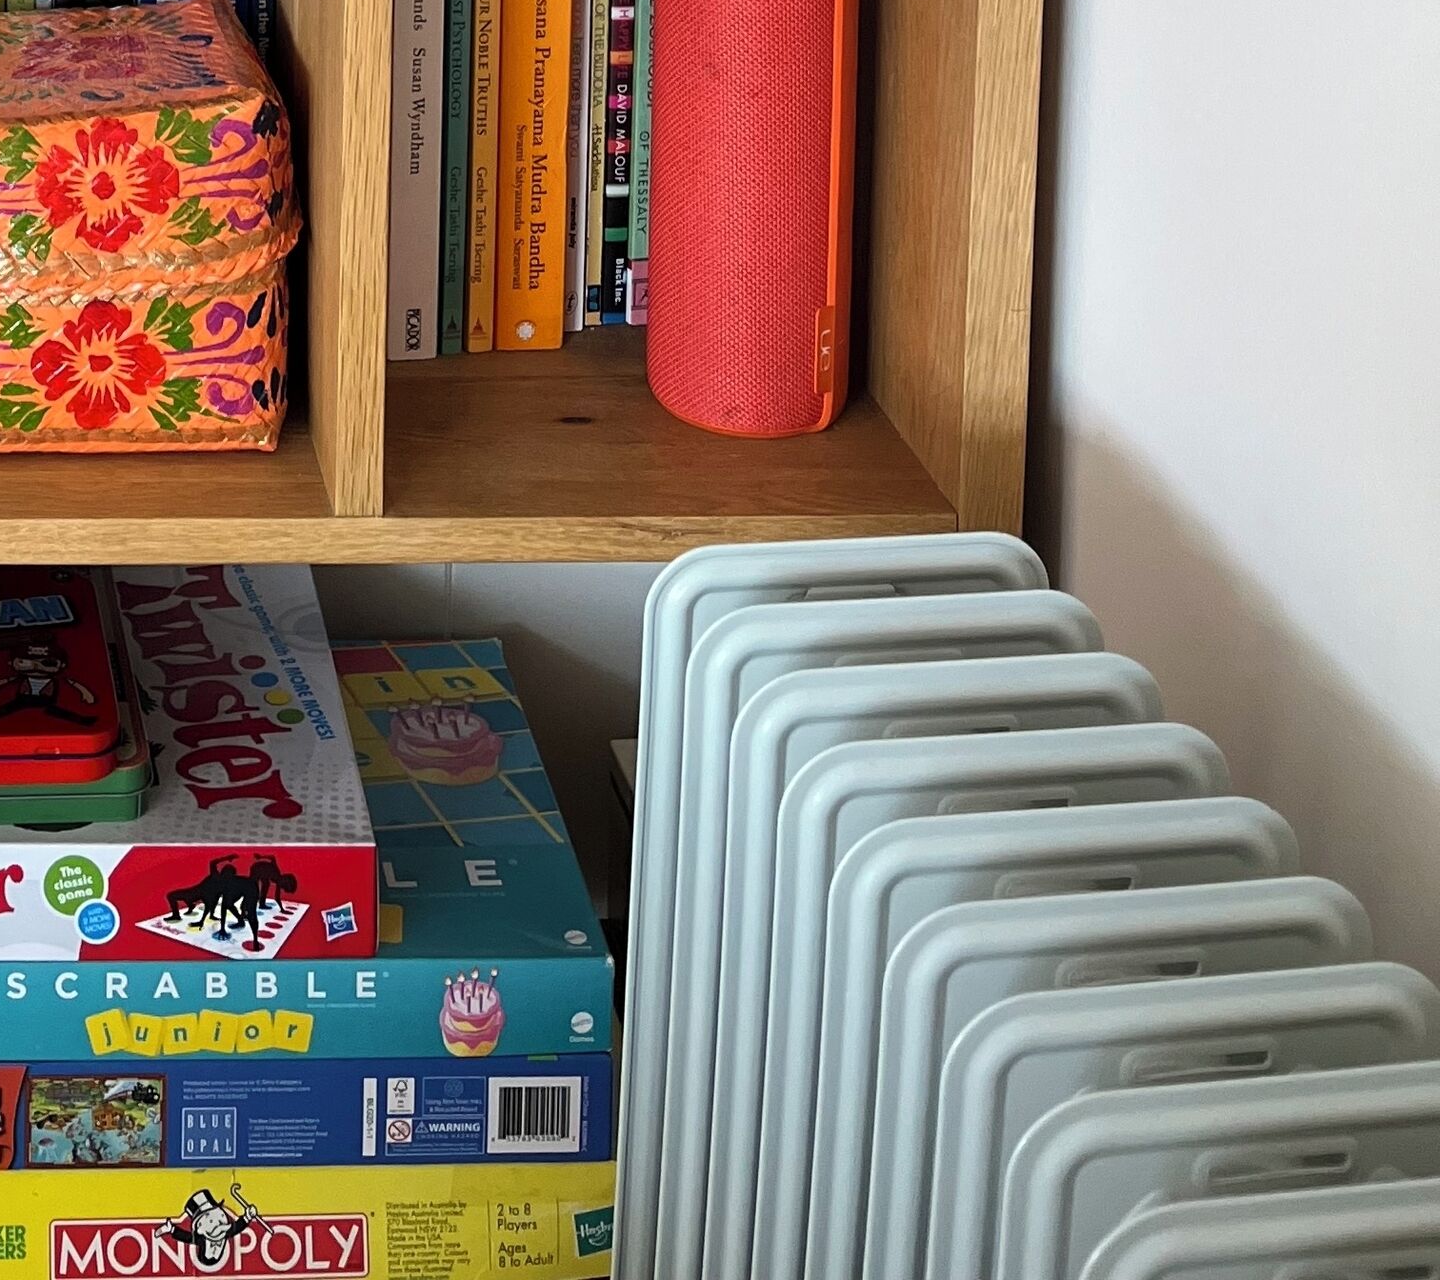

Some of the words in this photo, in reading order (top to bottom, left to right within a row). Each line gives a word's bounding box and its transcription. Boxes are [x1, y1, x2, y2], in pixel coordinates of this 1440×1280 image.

[258, 12, 270, 35] the
[411, 47, 427, 93] Susan
[530, 46, 552, 148] Pranayama
[408, 97, 426, 176] Wyndham
[640, 130, 650, 151] OF
[530, 153, 548, 215] Mudra
[636, 159, 650, 236] THESSALY
[528, 220, 546, 290] Bandha
[54, 875, 94, 890] classic
[59, 865, 82, 878] The
[57, 888, 94, 904] game
[6, 971, 378, 999] SCRABBLE
[102, 1019, 300, 1048] junior
[187, 1113, 232, 1129] BLUE
[187, 1138, 232, 1153] OPAL
[497, 1203, 505, 1216] 2
[509, 1204, 519, 1216] to
[523, 1203, 531, 1216] 8
[497, 1218, 538, 1232] Players
[60, 1220, 360, 1276] MONOPOLY
[498, 1241, 527, 1256] Ages
[498, 1255, 506, 1268] 8
[510, 1255, 521, 1267] to
[524, 1254, 554, 1267] Adult
